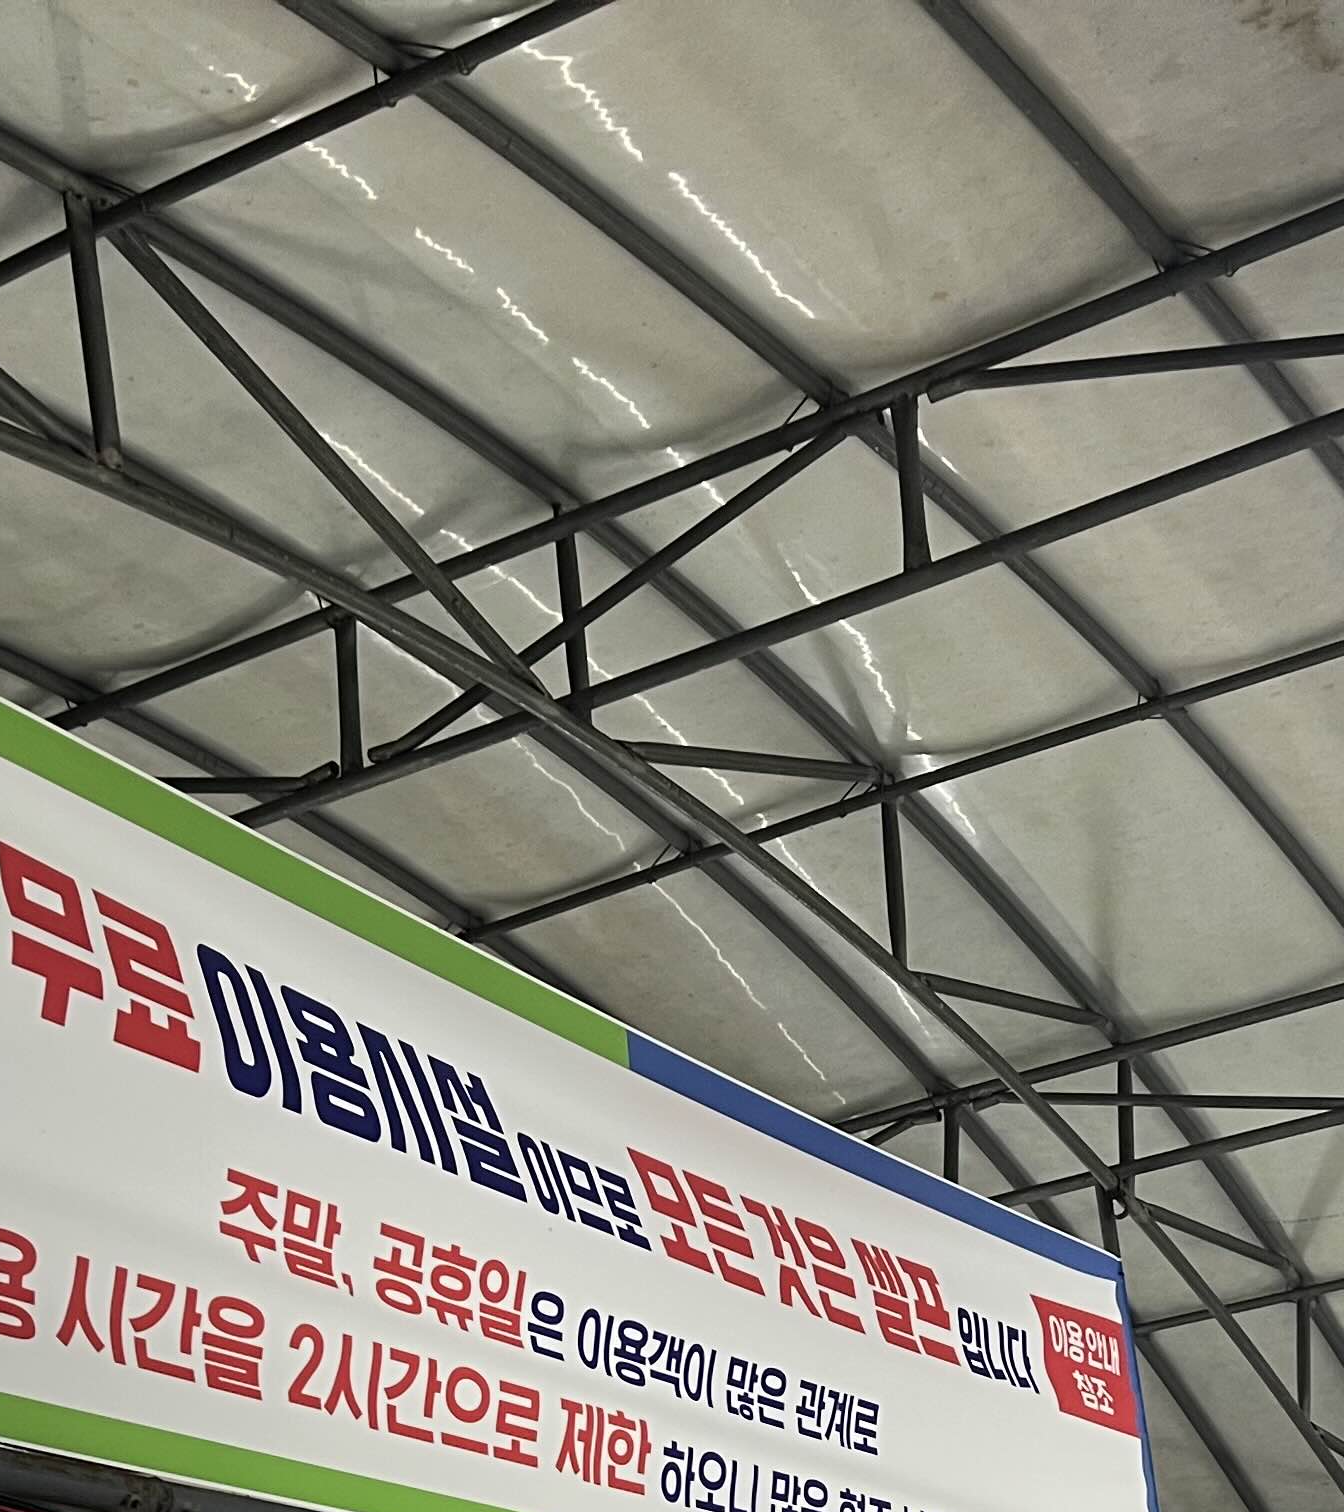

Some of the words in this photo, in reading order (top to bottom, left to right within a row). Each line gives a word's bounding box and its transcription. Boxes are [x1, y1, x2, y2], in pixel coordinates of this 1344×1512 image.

[56, 1256, 265, 1401] 시간을
[288, 1323, 540, 1468] 2시간으로
[219, 1168, 354, 1296] 주말,
[373, 1222, 565, 1362] 공휴일은
[578, 1308, 716, 1409] 이용객이
[726, 1356, 787, 1430] 많은
[796, 1378, 880, 1455] 관계로
[1072, 1369, 1115, 1416] 참조
